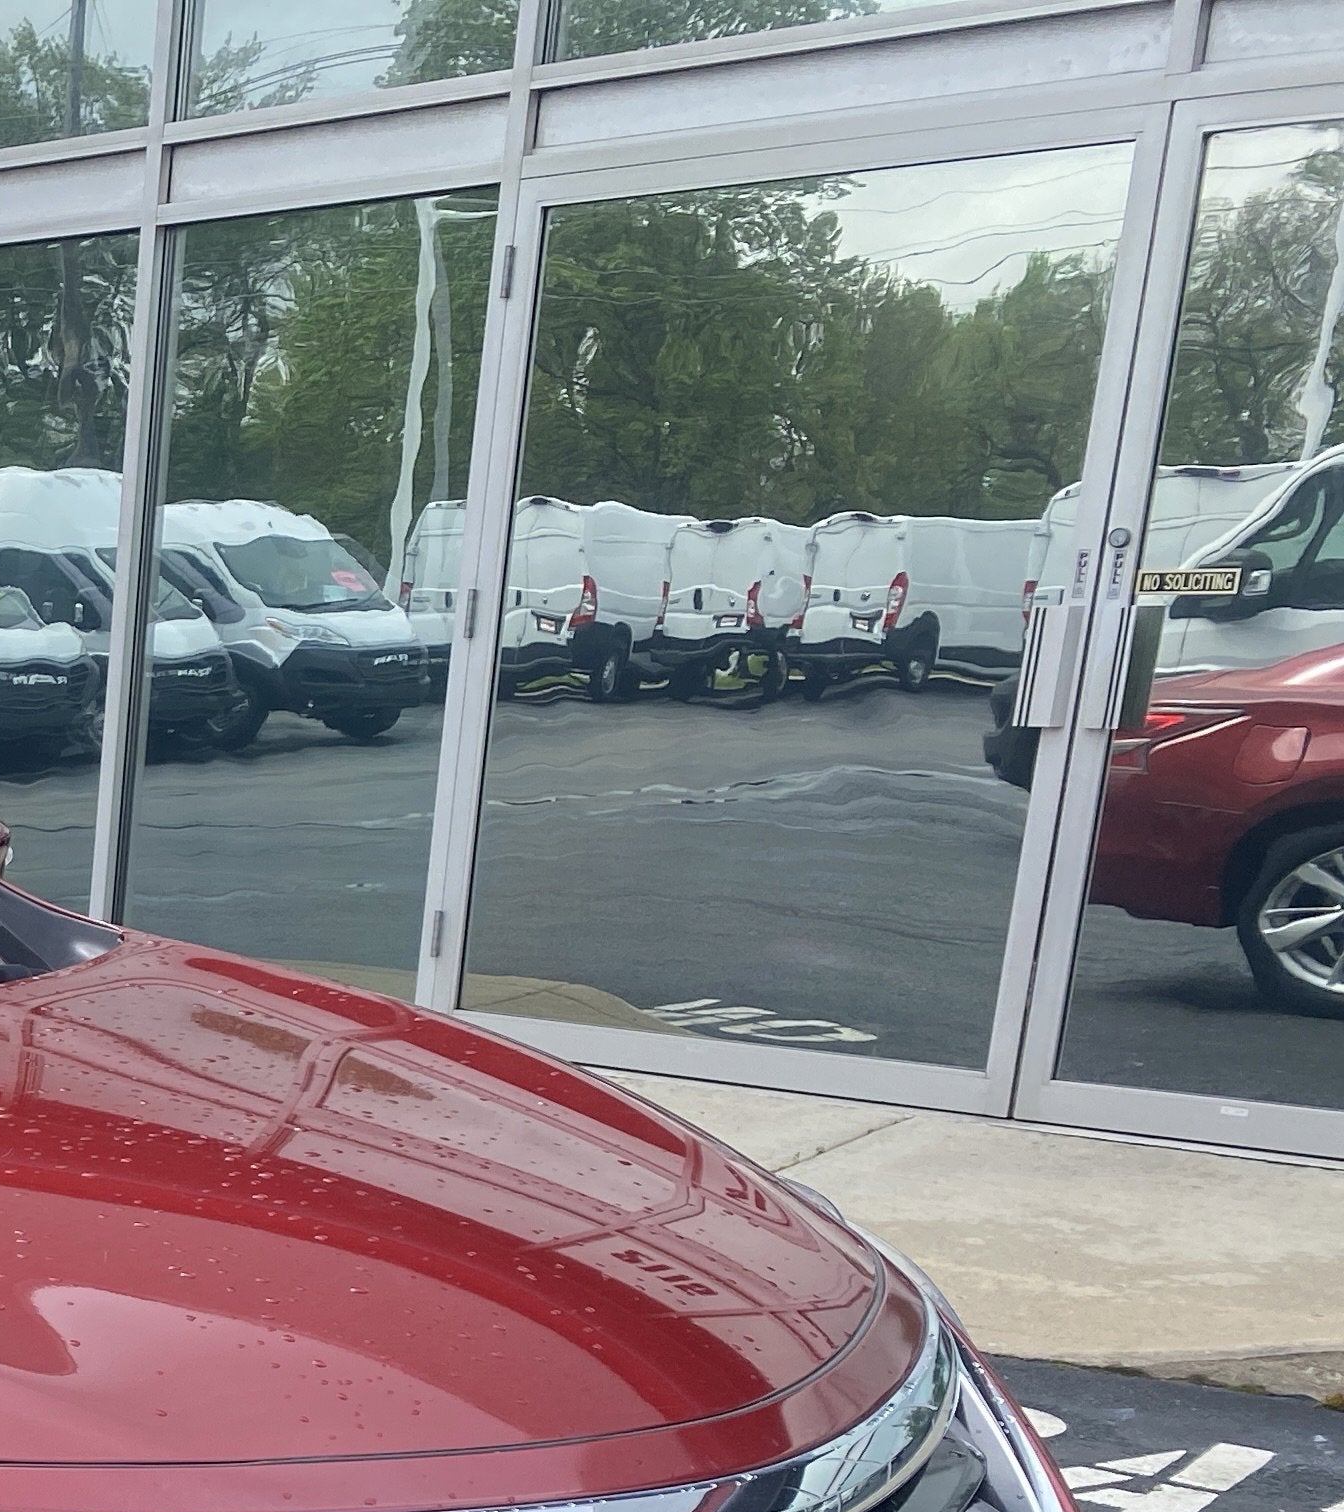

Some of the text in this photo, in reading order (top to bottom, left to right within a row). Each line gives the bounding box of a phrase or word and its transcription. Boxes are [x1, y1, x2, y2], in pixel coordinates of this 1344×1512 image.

[1077, 552, 1088, 583] PULL
[1112, 553, 1124, 584] PULL
[1143, 572, 1234, 591] NO SOLICITING
